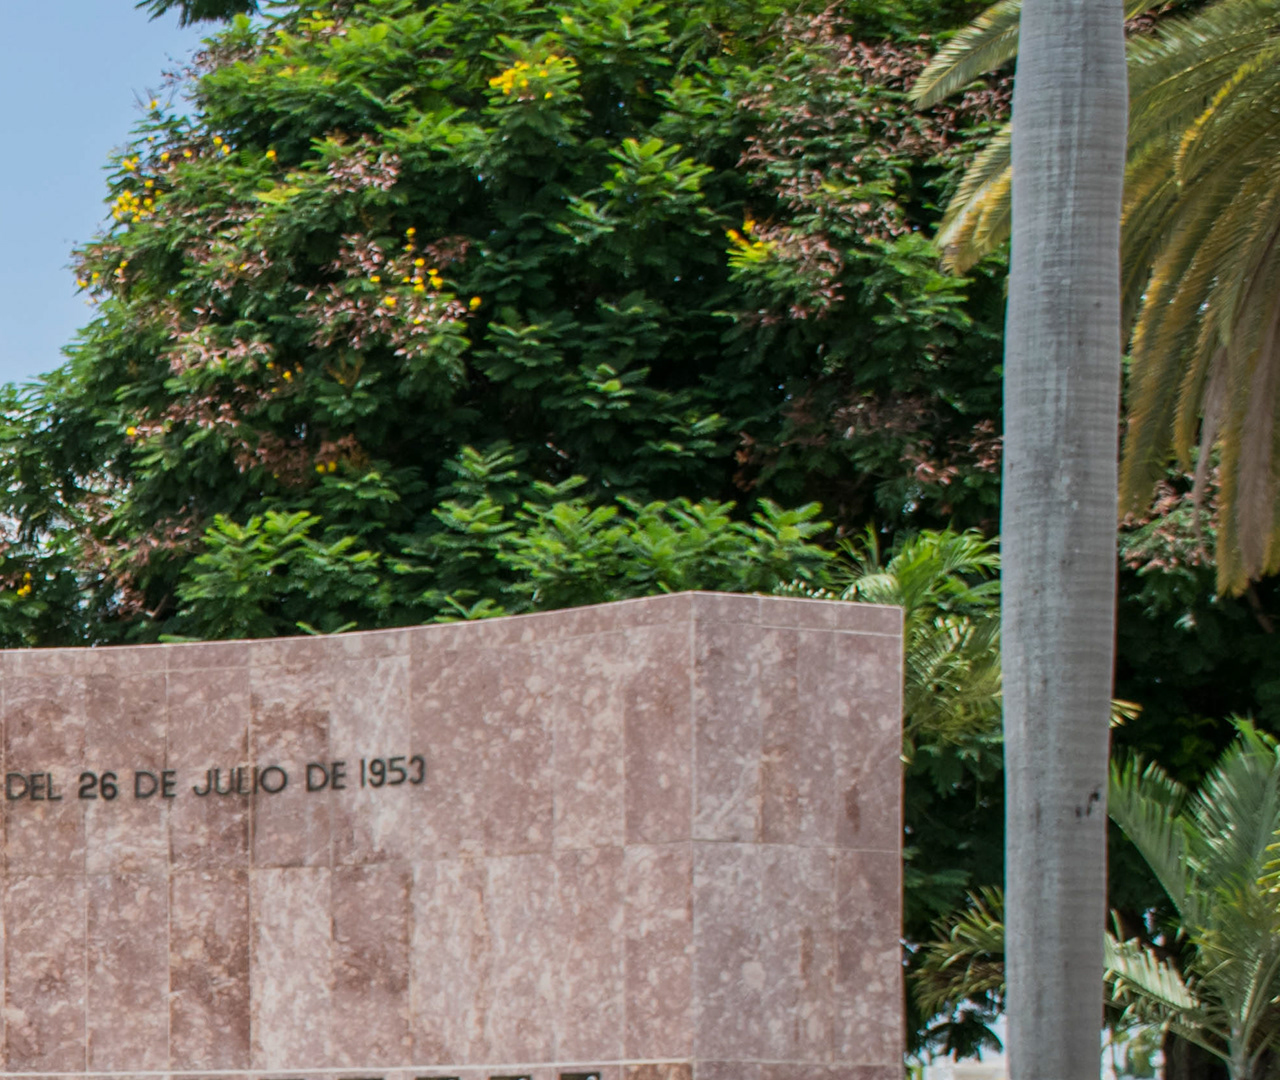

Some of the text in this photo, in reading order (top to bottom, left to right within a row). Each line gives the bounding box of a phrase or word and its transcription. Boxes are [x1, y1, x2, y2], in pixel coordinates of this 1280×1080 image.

[5, 772, 62, 802] DEL
[77, 771, 118, 801] 26
[134, 770, 176, 799] DE
[192, 765, 288, 798] JULIO
[305, 762, 346, 792] DE
[360, 755, 425, 789] 1953
